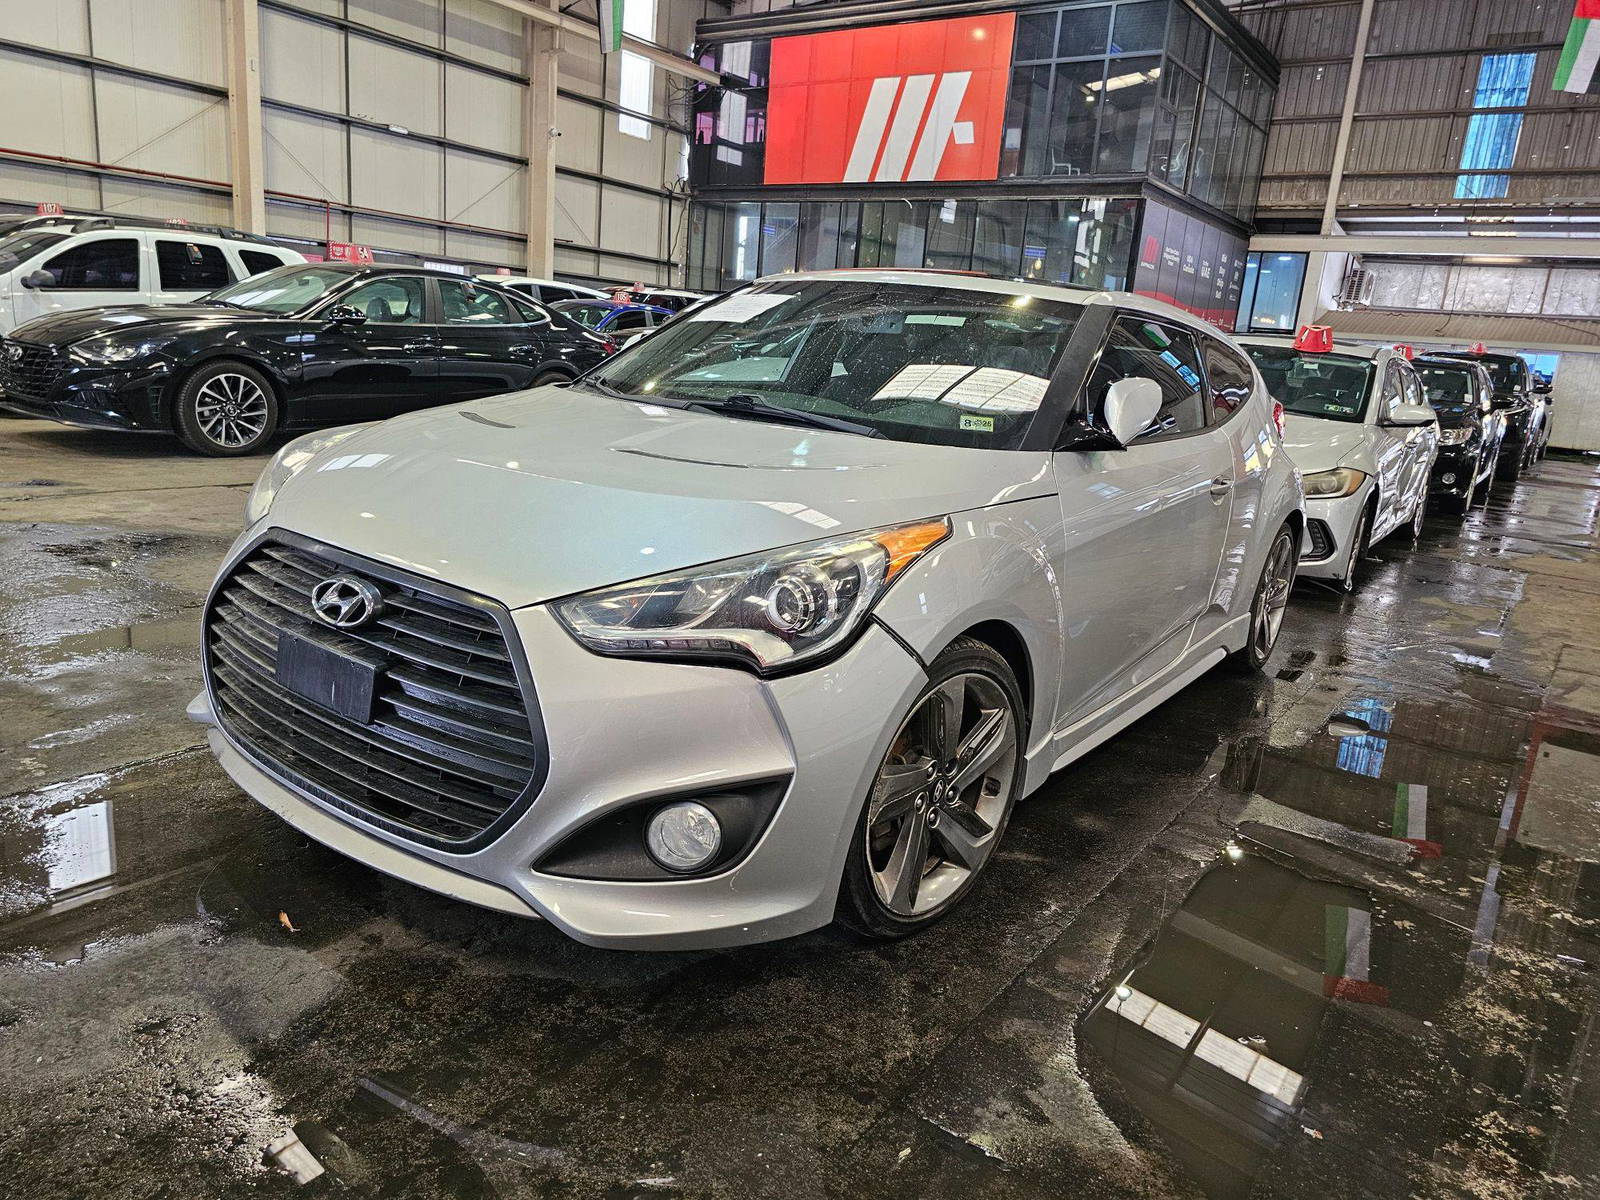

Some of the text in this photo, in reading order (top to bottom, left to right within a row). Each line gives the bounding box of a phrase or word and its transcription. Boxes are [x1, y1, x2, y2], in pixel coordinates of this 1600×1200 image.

[43, 203, 57, 213] 107
[358, 247, 369, 259] 54
[964, 419, 972, 428] 8
